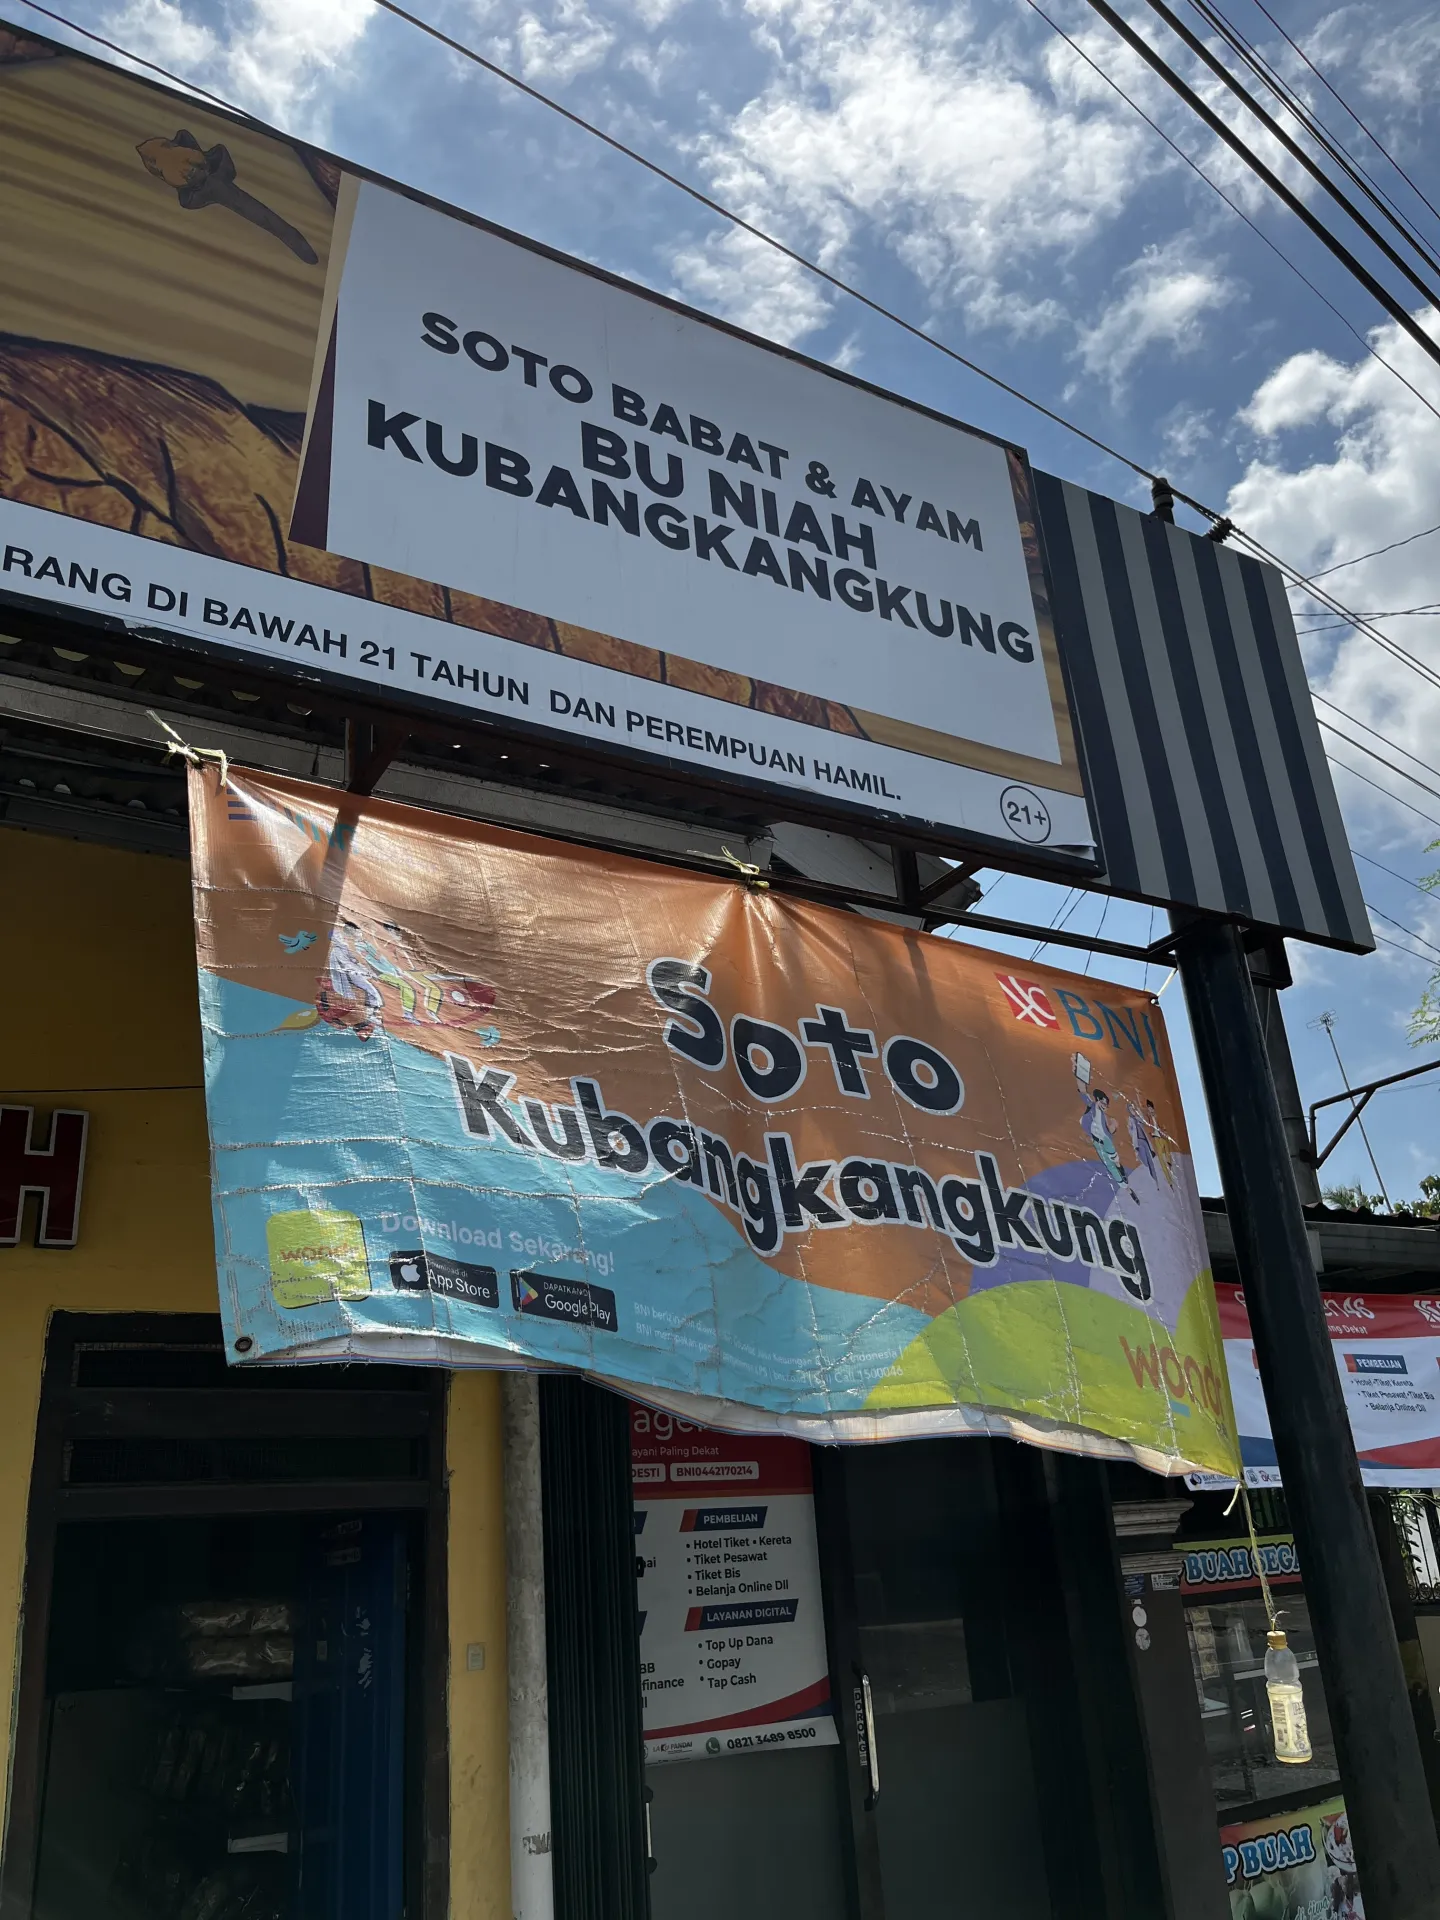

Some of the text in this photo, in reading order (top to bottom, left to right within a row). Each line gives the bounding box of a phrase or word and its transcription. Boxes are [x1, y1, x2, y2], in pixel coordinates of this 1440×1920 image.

[420, 312, 984, 552] SOTO BABAT & AYAM
[581, 420, 878, 571] BU NIAH
[367, 399, 1035, 664] KUBANGKANGKUNG
[2, 545, 902, 801] RANG DI BAWAH 21 TAHUN DAN PEREMPUAN HAMIL.
[1005, 799, 1047, 828] 21+
[646, 957, 965, 1116] Soto
[1052, 988, 1162, 1068] BNI
[444, 1052, 1157, 1305] Kubangkangkung
[381, 1211, 502, 1250] Download
[429, 1268, 490, 1299] App Store
[544, 1293, 611, 1325] Google Play
[634, 1302, 650, 1317] BNI
[1355, 1358, 1403, 1370] PEMBELIAN
[660, 1445, 690, 1458] Paling
[691, 1445, 719, 1456] Dekat
[676, 1465, 753, 1478] BNI0442170214
[703, 1513, 758, 1525] PEMBELIAN
[693, 1535, 792, 1550] Hotel Tiket Kereta
[694, 1551, 768, 1566] Tiket Pesawat
[1184, 1548, 1253, 1584] BUAH
[695, 1568, 741, 1582] Tiket Bis
[696, 1579, 789, 1597] Belanja Online Dll
[707, 1605, 792, 1623] LAYANAN DIGITAL
[705, 1634, 774, 1652] Top Up Dana
[707, 1657, 742, 1671] Gopay
[708, 1672, 757, 1690] Tap Cash
[854, 1692, 867, 1753] DORONG
[726, 1727, 817, 1750] 0821 3489 8500
[1239, 1825, 1316, 1879] BUAH
